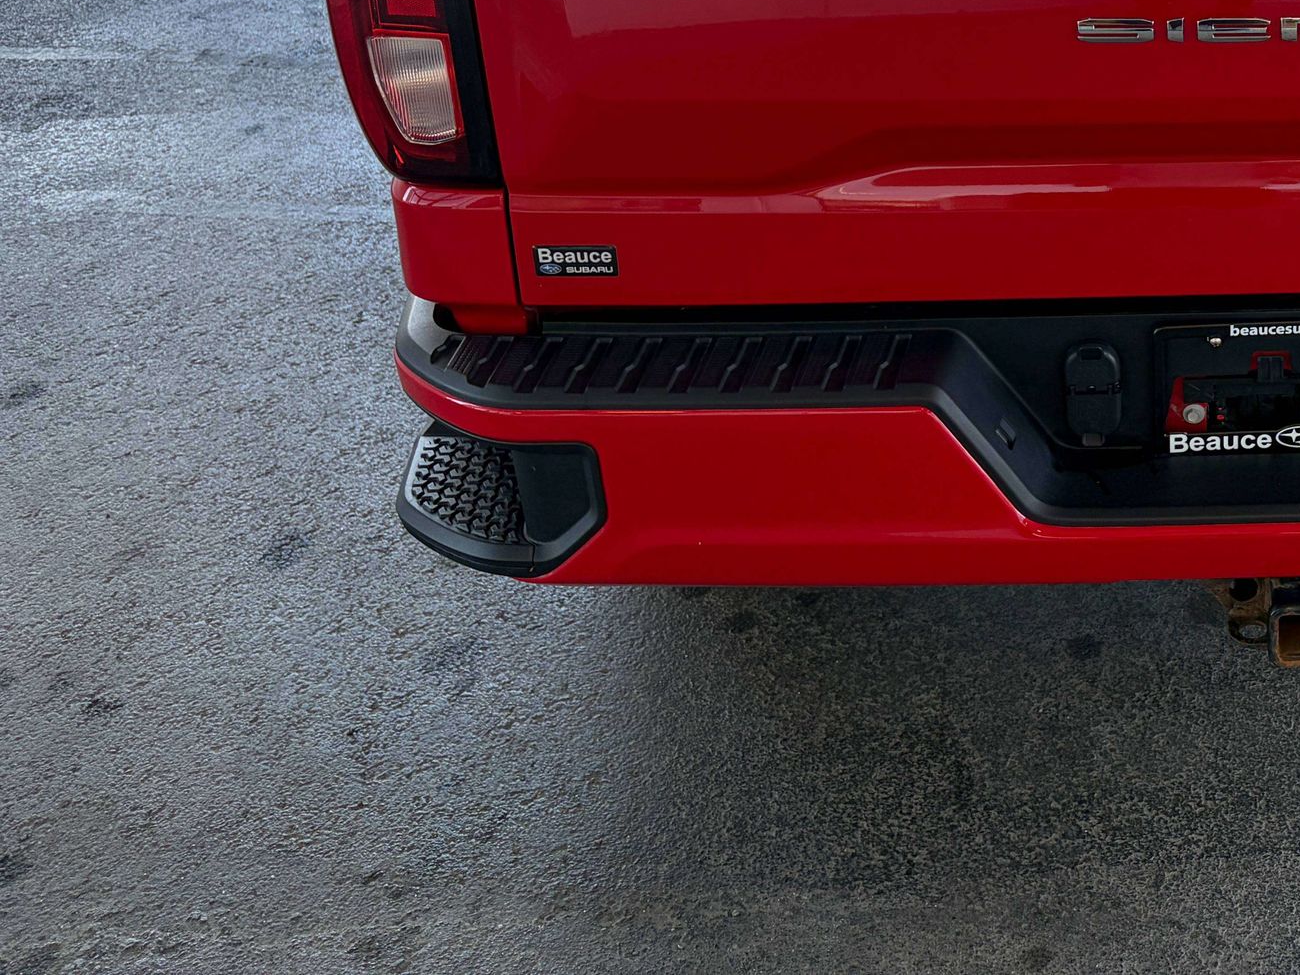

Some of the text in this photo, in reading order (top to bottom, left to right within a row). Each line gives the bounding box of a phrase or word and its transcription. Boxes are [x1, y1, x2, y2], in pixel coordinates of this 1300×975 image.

[537, 248, 613, 263] Beauce
[566, 266, 614, 274] SUBARU
[1169, 431, 1273, 454] Beauce
